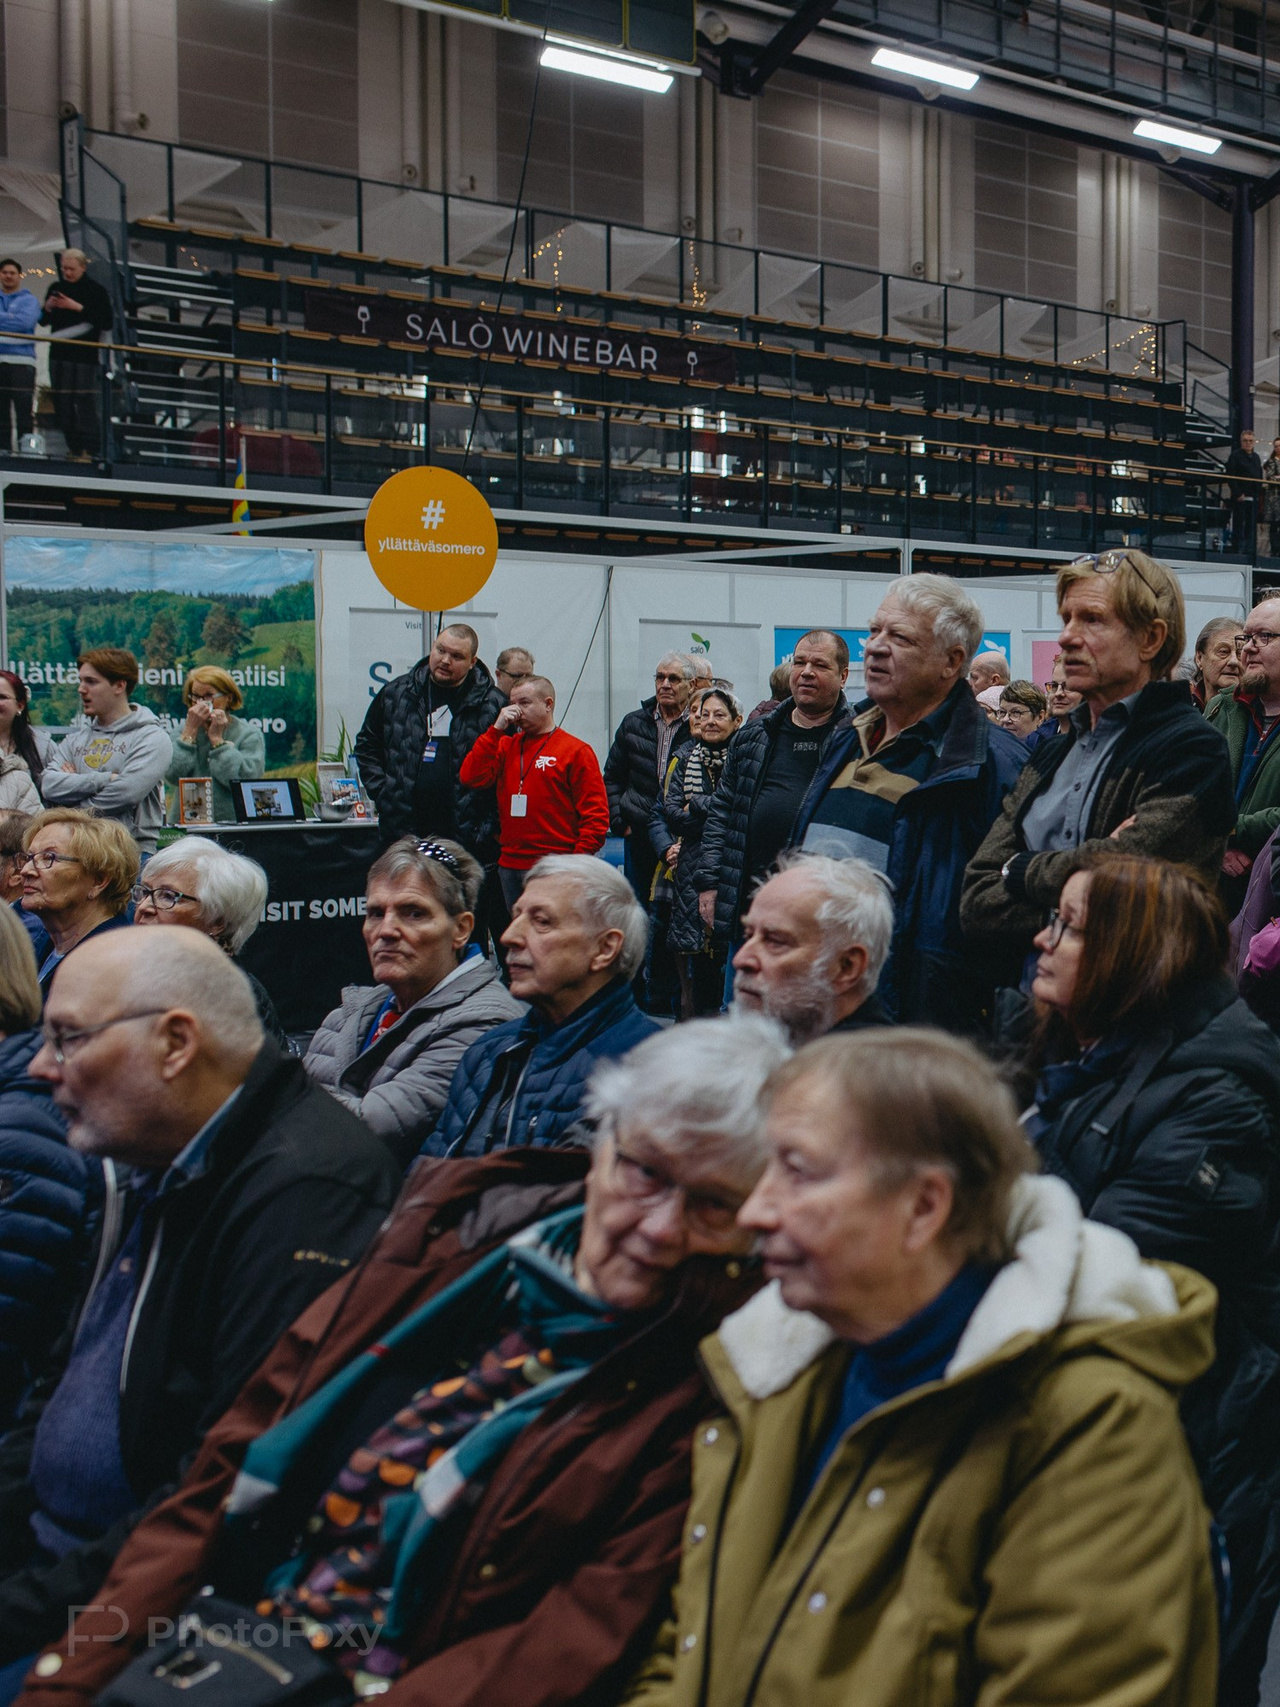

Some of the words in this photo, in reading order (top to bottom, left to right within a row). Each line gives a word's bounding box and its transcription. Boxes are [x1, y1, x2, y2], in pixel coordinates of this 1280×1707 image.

[502, 325, 658, 372] WINEBAR
[378, 537, 485, 556] yllättäväsomero
[9, 661, 80, 684] llättä
[137, 663, 183, 686] ieni
[230, 665, 286, 687] atiisi
[260, 901, 305, 922] ISIT
[309, 897, 368, 919] SOME
